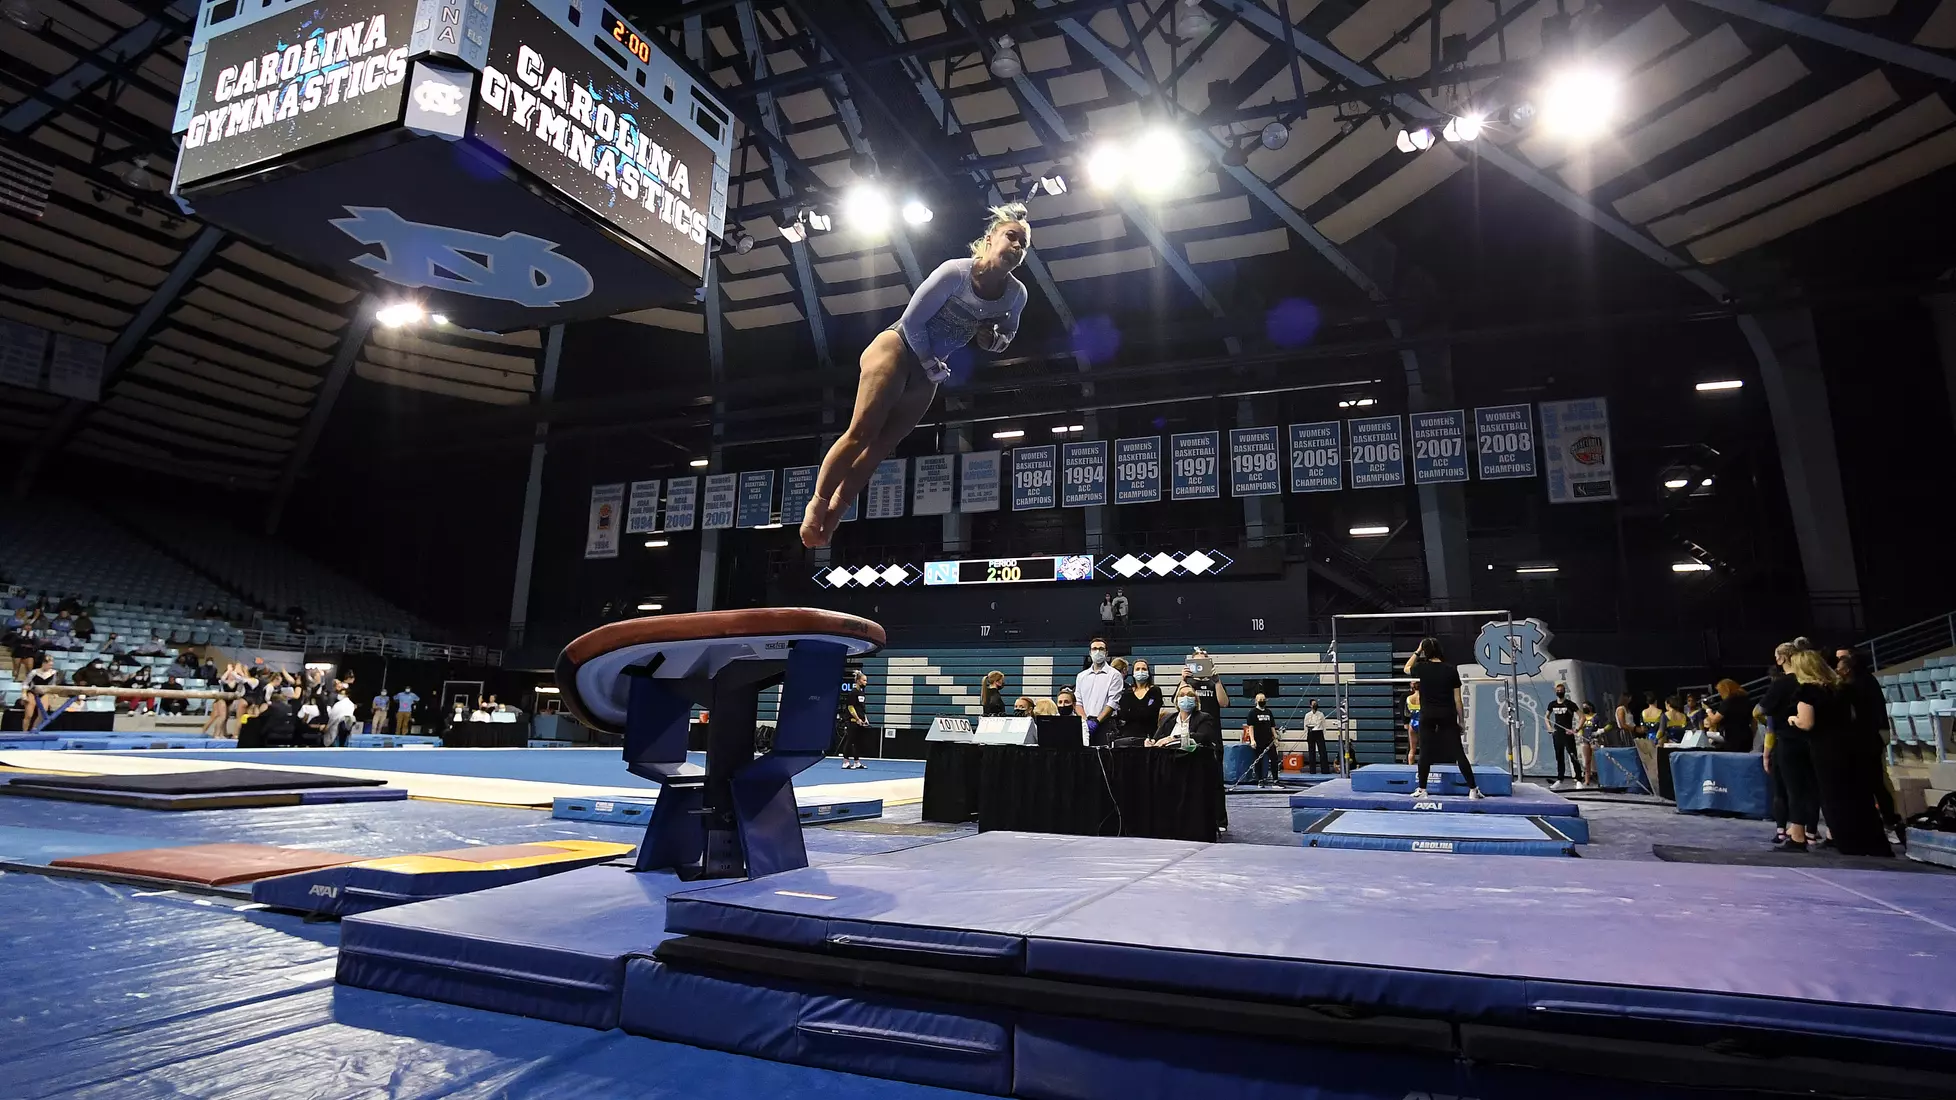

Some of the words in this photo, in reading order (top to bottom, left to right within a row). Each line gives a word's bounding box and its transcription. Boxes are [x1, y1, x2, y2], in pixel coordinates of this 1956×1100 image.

[612, 20, 650, 64] 2:00
[214, 13, 388, 103] CAROLINA
[184, 44, 411, 149] GYMNASTICS
[516, 44, 691, 199] CAROLINA
[480, 65, 707, 246] GYMNASTICS
[1480, 422, 1528, 432] BASKETBALL
[1353, 433, 1397, 443] BASKETBALL
[1415, 428, 1461, 438] BASKETBALL
[1234, 443, 1274, 452] BASKETBALL
[1294, 438, 1336, 448] BASKETBALL
[1416, 438, 1461, 458] 2007
[1481, 433, 1531, 453] 2008
[1118, 452, 1157, 461] BASKETBALL
[1175, 448, 1215, 457] BASKETBALL
[1353, 443, 1400, 463] 2006
[1066, 457, 1103, 465] BASKETBALL
[1233, 453, 1277, 472] 1998
[1293, 448, 1338, 468] 2005
[1433, 459, 1448, 467] ACC
[1499, 454, 1515, 462] ACC
[1016, 461, 1052, 470] BASKETBALL
[1175, 457, 1215, 476] 1997
[1370, 464, 1385, 472] ACC
[1484, 463, 1531, 474] CHAMPIONS
[1065, 466, 1104, 484] 1994
[1118, 462, 1158, 481] 1995
[1419, 468, 1464, 478] CHAMPIONS
[1015, 470, 1052, 488] 1984
[1248, 473, 1263, 481] ACC
[1295, 477, 1337, 487] CHAMPIONS
[1356, 473, 1400, 483] CHAMPIONS
[1175, 486, 1215, 495] CHAMPIONS
[1236, 481, 1276, 491] CHAMPIONS
[1027, 488, 1040, 496] ACC
[1119, 489, 1157, 499] CHAMPIONS
[1016, 496, 1051, 505] CHAMPIONS
[1066, 493, 1102, 502] CHAMPIONS
[988, 559, 1017, 568] PERIOD
[987, 567, 1021, 582] 2:00
[1252, 619, 1265, 631] 118
[980, 625, 991, 636] 117
[1288, 757, 1298, 767] G
[1412, 841, 1453, 852] CAROLINA
